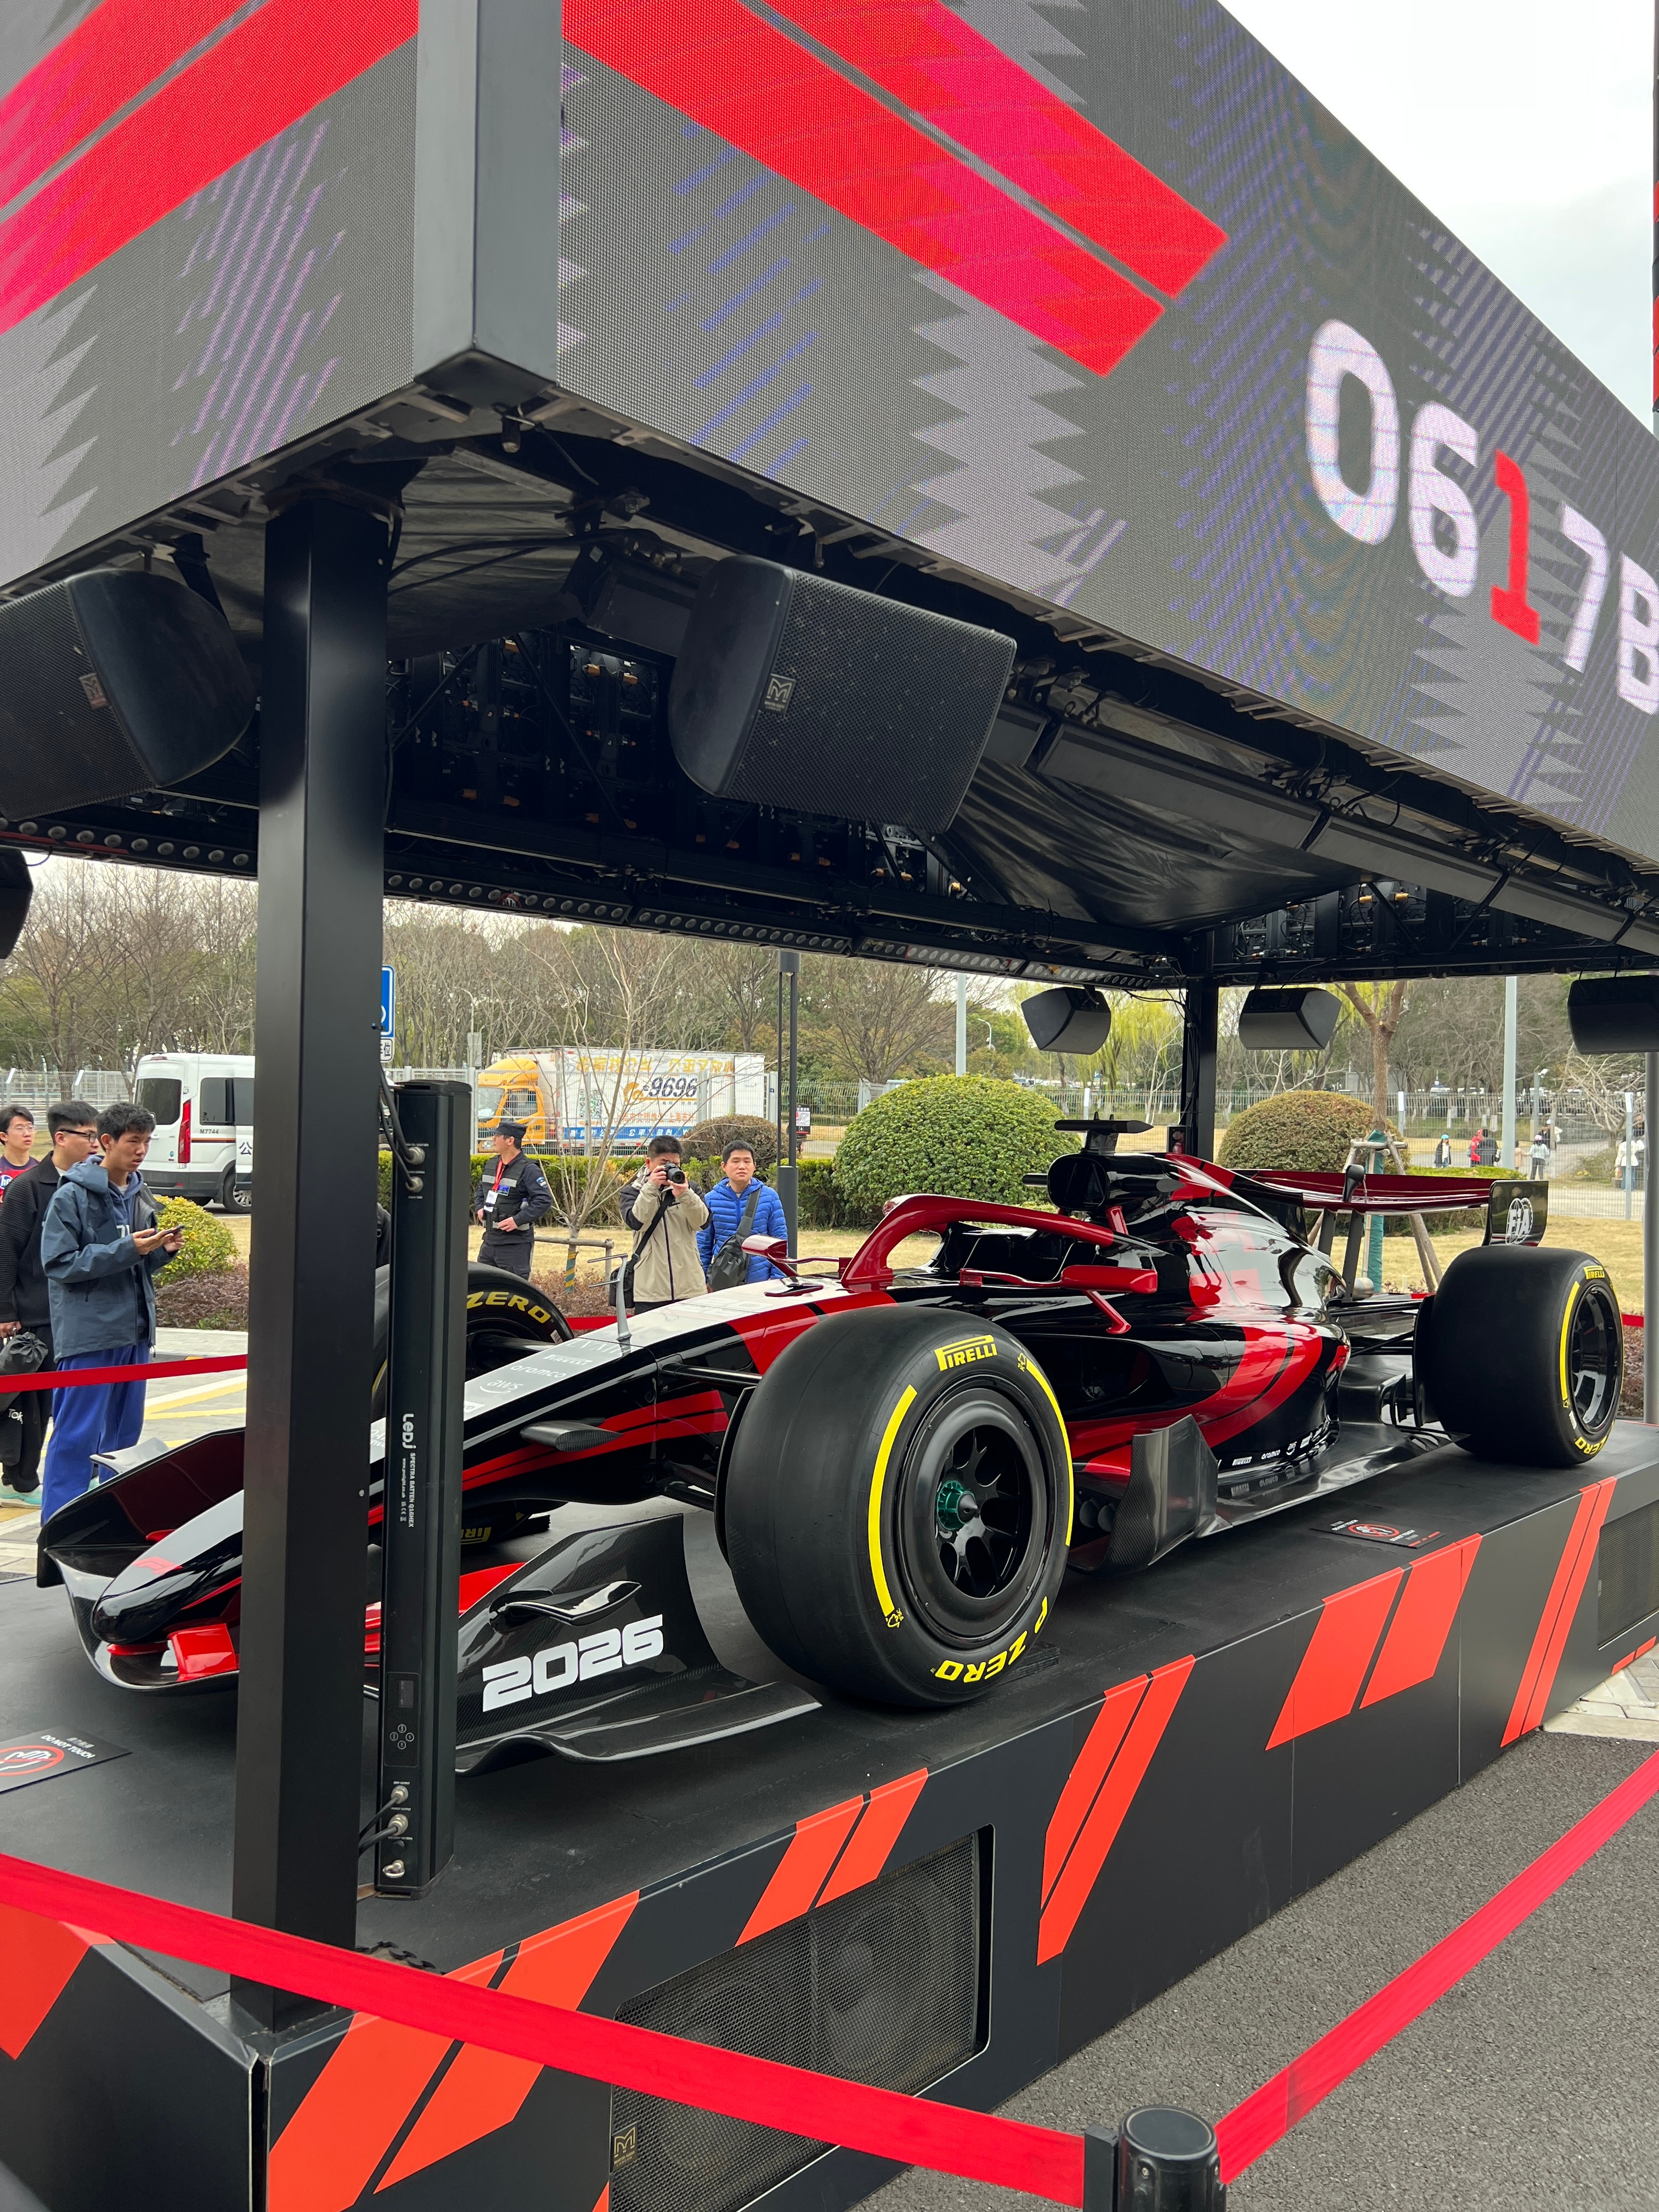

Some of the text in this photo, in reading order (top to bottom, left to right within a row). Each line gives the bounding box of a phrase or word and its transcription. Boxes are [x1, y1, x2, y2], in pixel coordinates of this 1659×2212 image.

[380, 1042, 391, 1057] 位
[239, 1142, 252, 1155] 公
[1583, 1265, 1605, 1280] PIRELLI
[466, 1291, 551, 1324] ZERO
[543, 1354, 593, 1365] PIRELLI
[934, 1334, 997, 1371] PIRELLI
[510, 1364, 567, 1378] aramco
[486, 1379, 524, 1391] aws
[935, 1596, 1048, 1683] P ZERO
[482, 1615, 664, 1712] 2026
[51, 1739, 72, 1748] NOT
[67, 1746, 96, 1759] TOUCH
